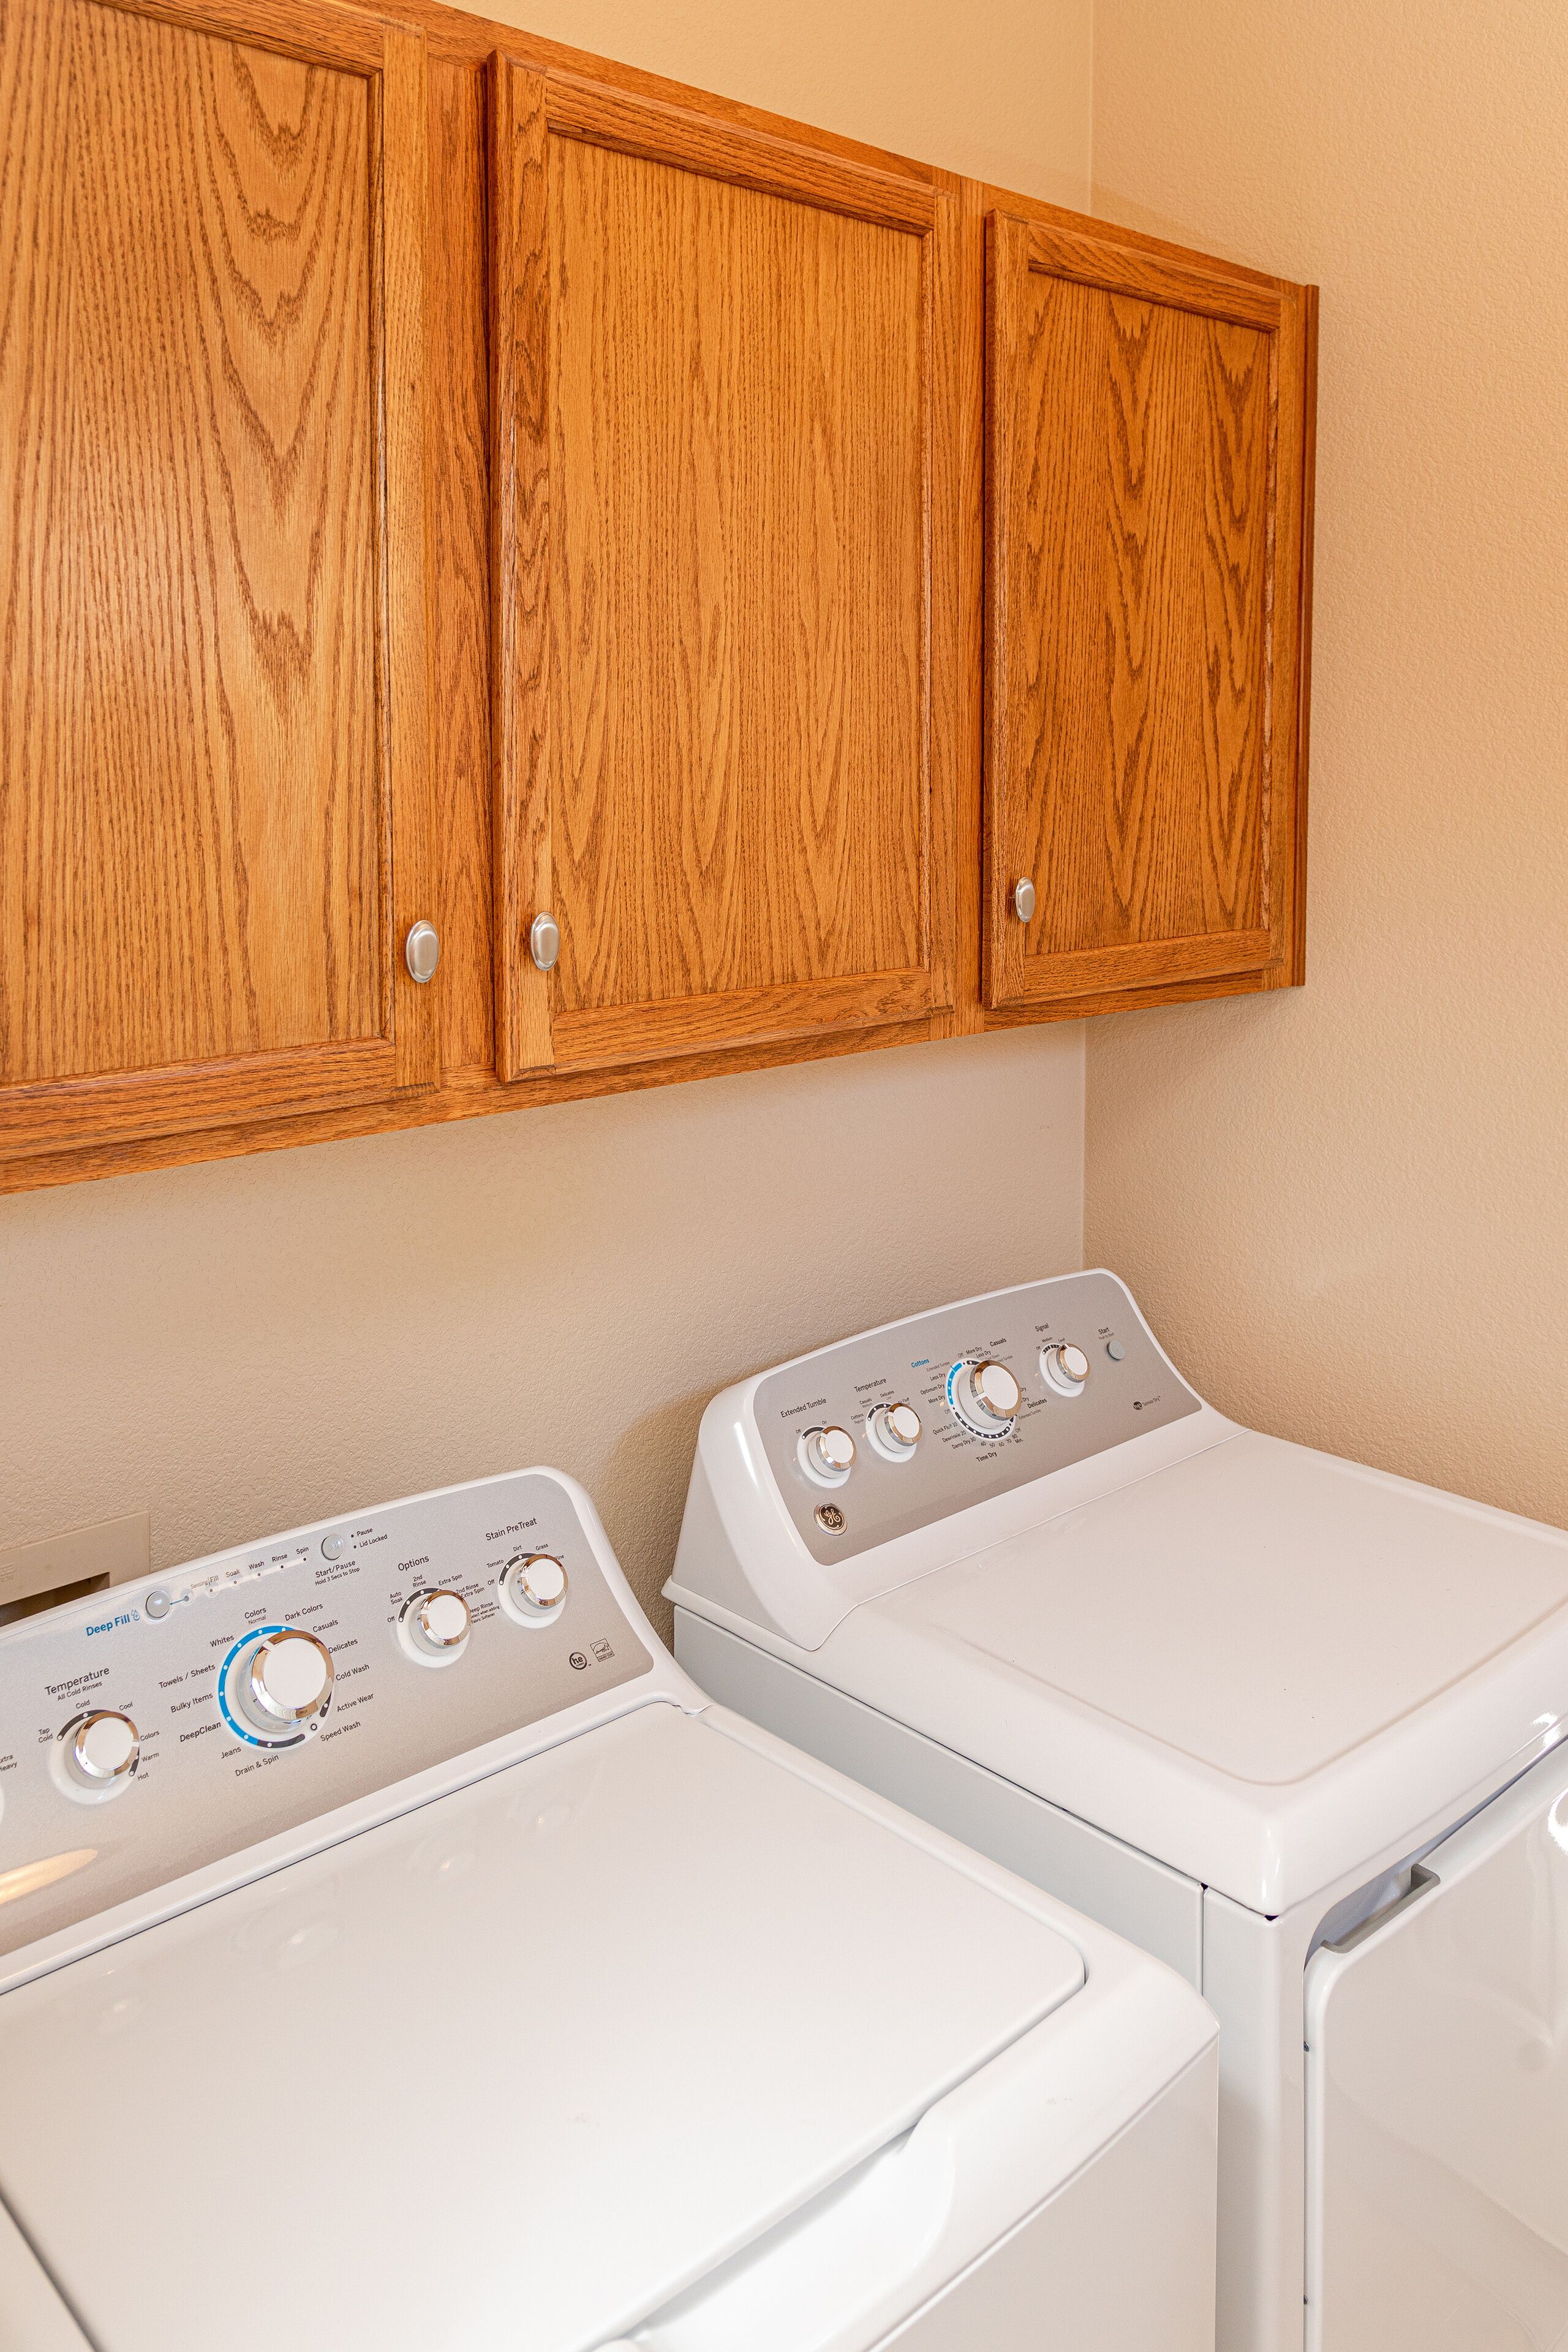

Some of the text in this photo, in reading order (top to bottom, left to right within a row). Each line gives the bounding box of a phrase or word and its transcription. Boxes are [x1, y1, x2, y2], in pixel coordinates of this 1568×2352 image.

[1035, 1323, 1049, 1332] Signal
[990, 1338, 1007, 1347] Casuals
[911, 1359, 930, 1368] Cottons
[854, 1378, 887, 1393] Temperature
[920, 1385, 938, 1395] Optimum
[880, 1390, 895, 1398] Delicates
[780, 1398, 827, 1418] Extended Tumble
[1027, 1398, 1047, 1409] Delicates
[932, 1427, 944, 1435] Quick
[942, 1433, 961, 1442] Dewrinkle
[356, 1528, 373, 1537] Pause
[485, 1517, 537, 1541] Stain PreTreat
[368, 1534, 388, 1545] Locked
[296, 1547, 309, 1555] Spin
[271, 1554, 288, 1562] Rinse
[486, 1559, 504, 1568] Tomato
[248, 1561, 265, 1570] Wash
[315, 1560, 356, 1578] Start/Pause
[398, 1556, 429, 1572] Options
[225, 1569, 241, 1578] Soak
[349, 1567, 360, 1575] Stop
[190, 1575, 219, 1589] Sensing Fill
[451, 1574, 463, 1582] Spin
[413, 1580, 426, 1588] Rinse
[244, 1607, 266, 1619] Colors
[285, 1603, 323, 1621] Dark Colors
[86, 1614, 130, 1637] Deep Fill
[248, 1615, 266, 1625] Normal
[312, 1619, 339, 1633] Casuals
[209, 1634, 235, 1648] Whites
[328, 1638, 358, 1654] Delicates
[571, 1656, 583, 1665] he
[158, 1676, 184, 1689] Towels
[190, 1664, 216, 1677] Sheets
[336, 1664, 370, 1681] Cold Wash
[45, 1667, 110, 1696] Temperature
[66, 1689, 81, 1698] Cold
[82, 1681, 103, 1692] Rinses
[75, 1700, 90, 1709] Cold
[119, 1702, 133, 1711] Cool
[170, 1692, 213, 1713] Bulky Items
[336, 1692, 374, 1713] Active Wear
[38, 1727, 50, 1736] Tap
[140, 1730, 160, 1742] Colors
[179, 1722, 221, 1743] DeepClean
[320, 1721, 361, 1742] Speed Wash
[38, 1734, 53, 1743] Cold
[141, 1752, 160, 1763] Warm
[221, 1746, 241, 1759] Jeans
[0, 1754, 13, 1763] xtra
[235, 1763, 255, 1777] Drain
[262, 1754, 279, 1766] Spin
[137, 1772, 149, 1781] Hot
